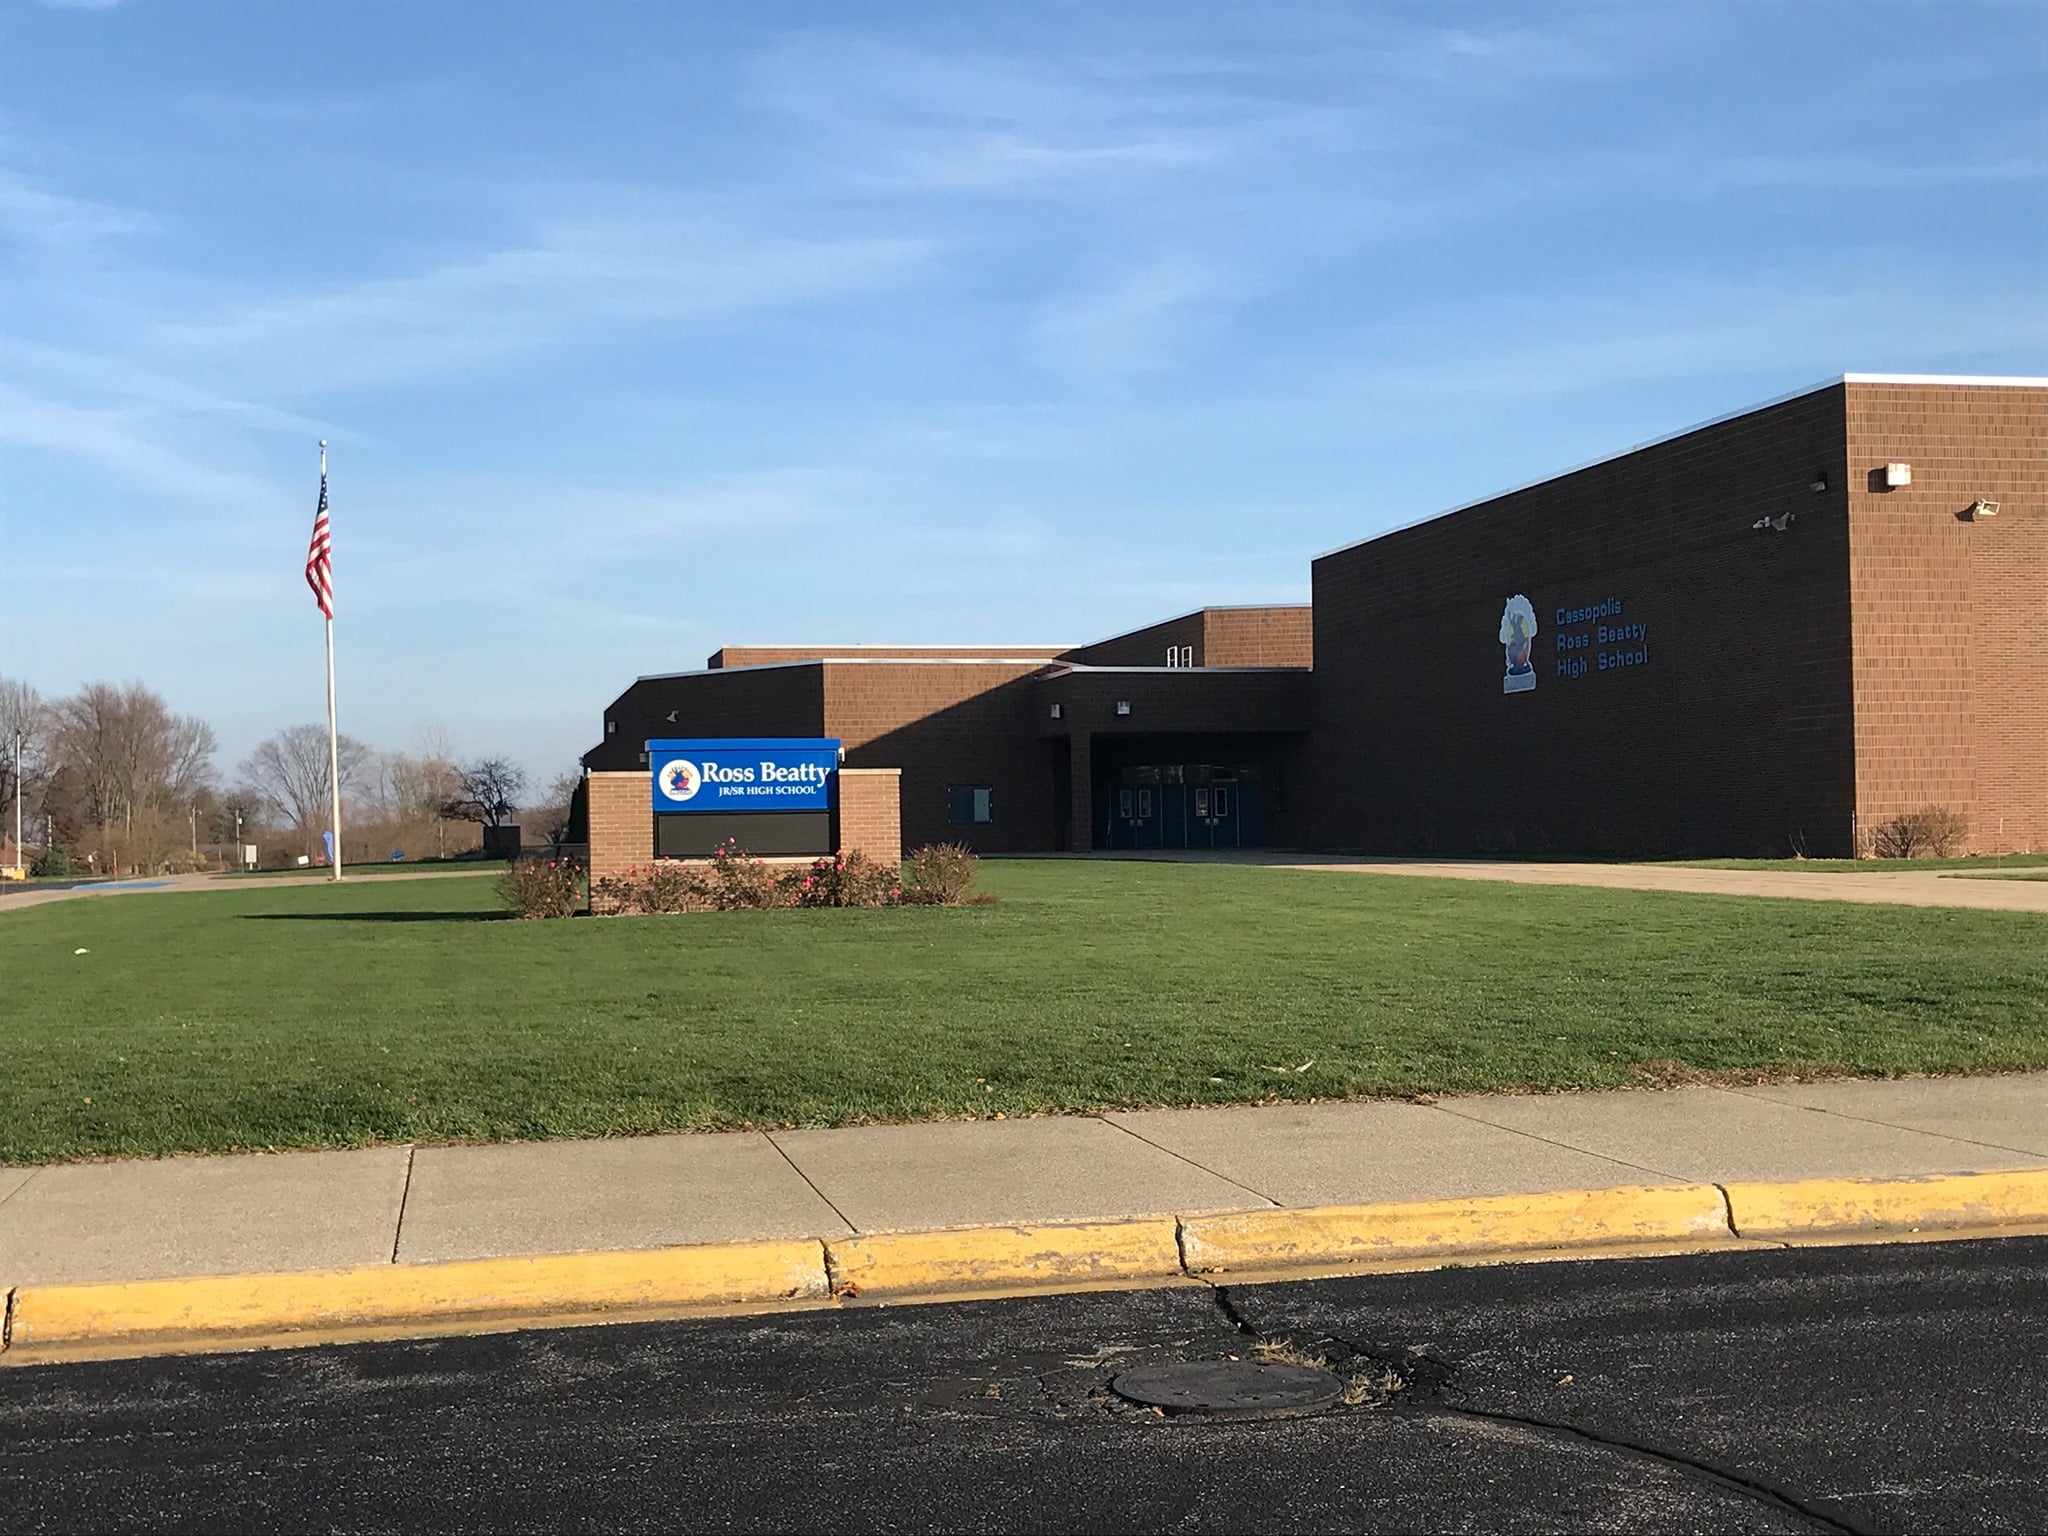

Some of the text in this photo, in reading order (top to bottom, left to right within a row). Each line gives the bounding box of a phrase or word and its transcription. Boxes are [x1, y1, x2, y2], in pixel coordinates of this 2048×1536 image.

[1556, 597, 1622, 625] Cassopolis
[1556, 623, 1647, 651] Ross Beatty
[1557, 644, 1648, 679] High School
[702, 762, 755, 783] Ross
[760, 762, 831, 788] Beatty
[719, 785, 817, 798] JR/SR HIGH SCHOOL
